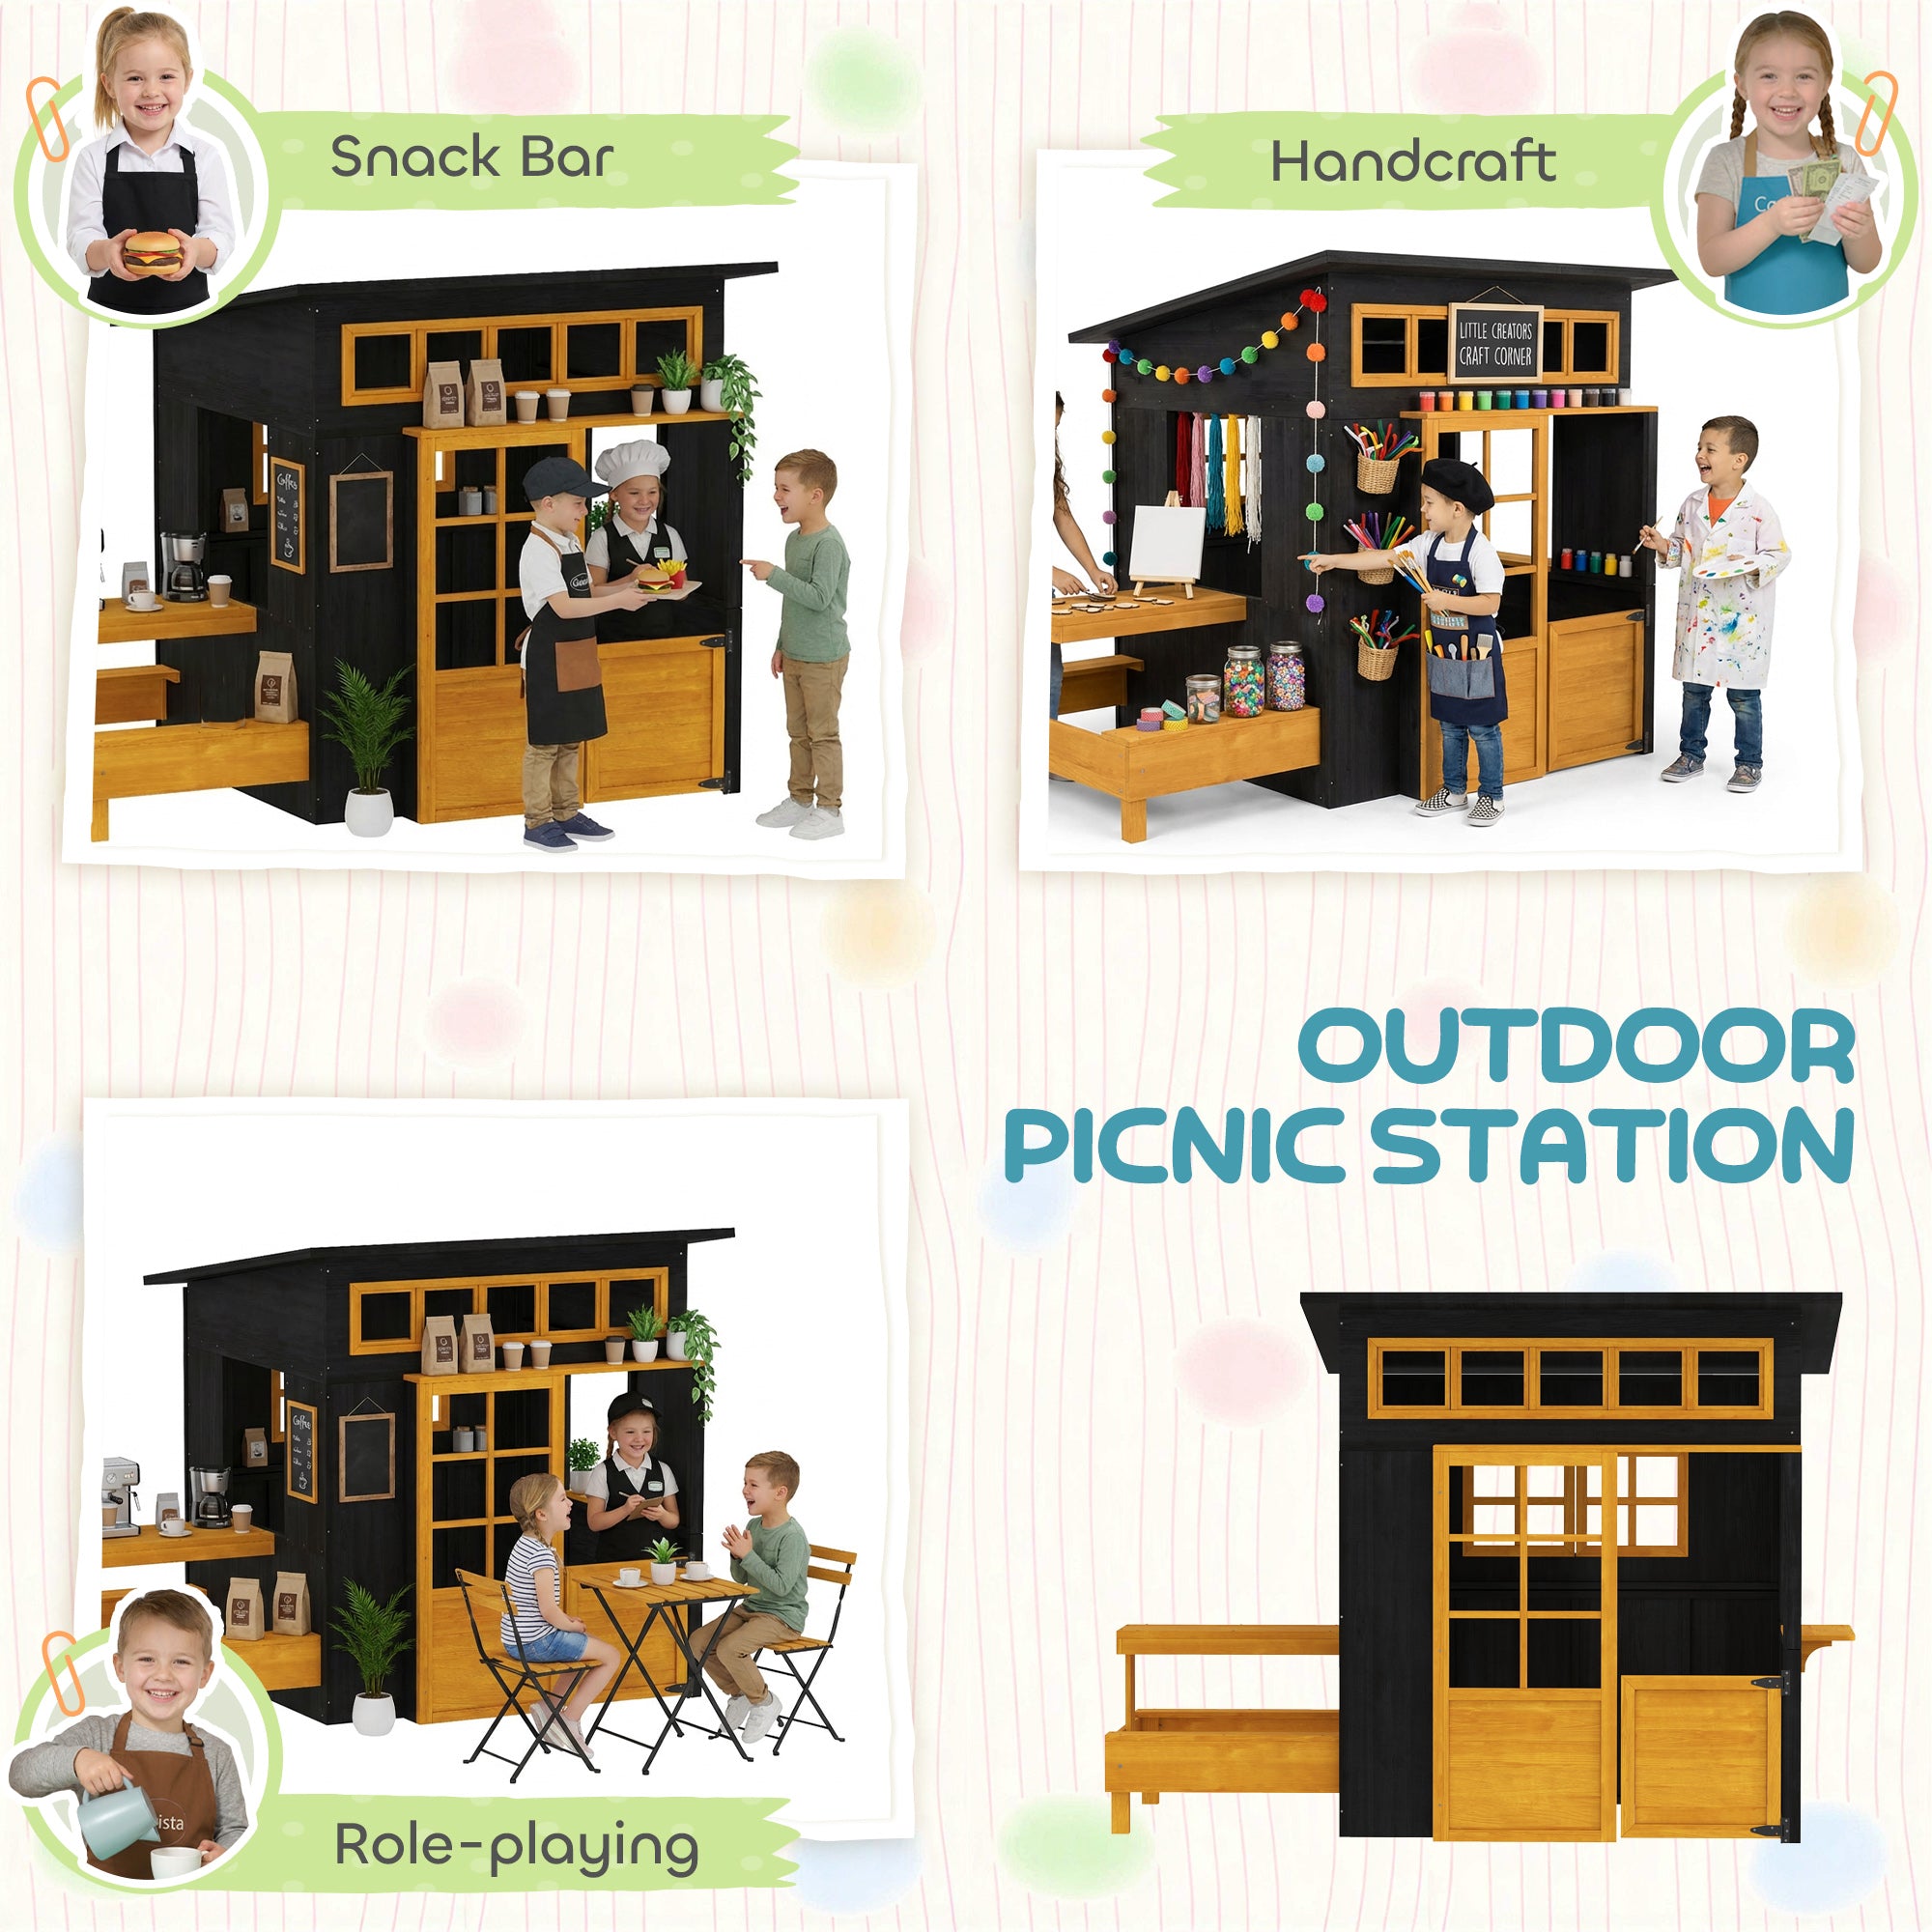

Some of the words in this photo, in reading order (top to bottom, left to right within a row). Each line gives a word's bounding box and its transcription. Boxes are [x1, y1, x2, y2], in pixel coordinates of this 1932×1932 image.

[1460, 322, 1488, 339] LITTLE
[1492, 323, 1533, 340] CREATORS
[1460, 346, 1490, 366] CRAFT
[1494, 347, 1532, 366] CORNER
[158, 1814, 185, 1831] ista
